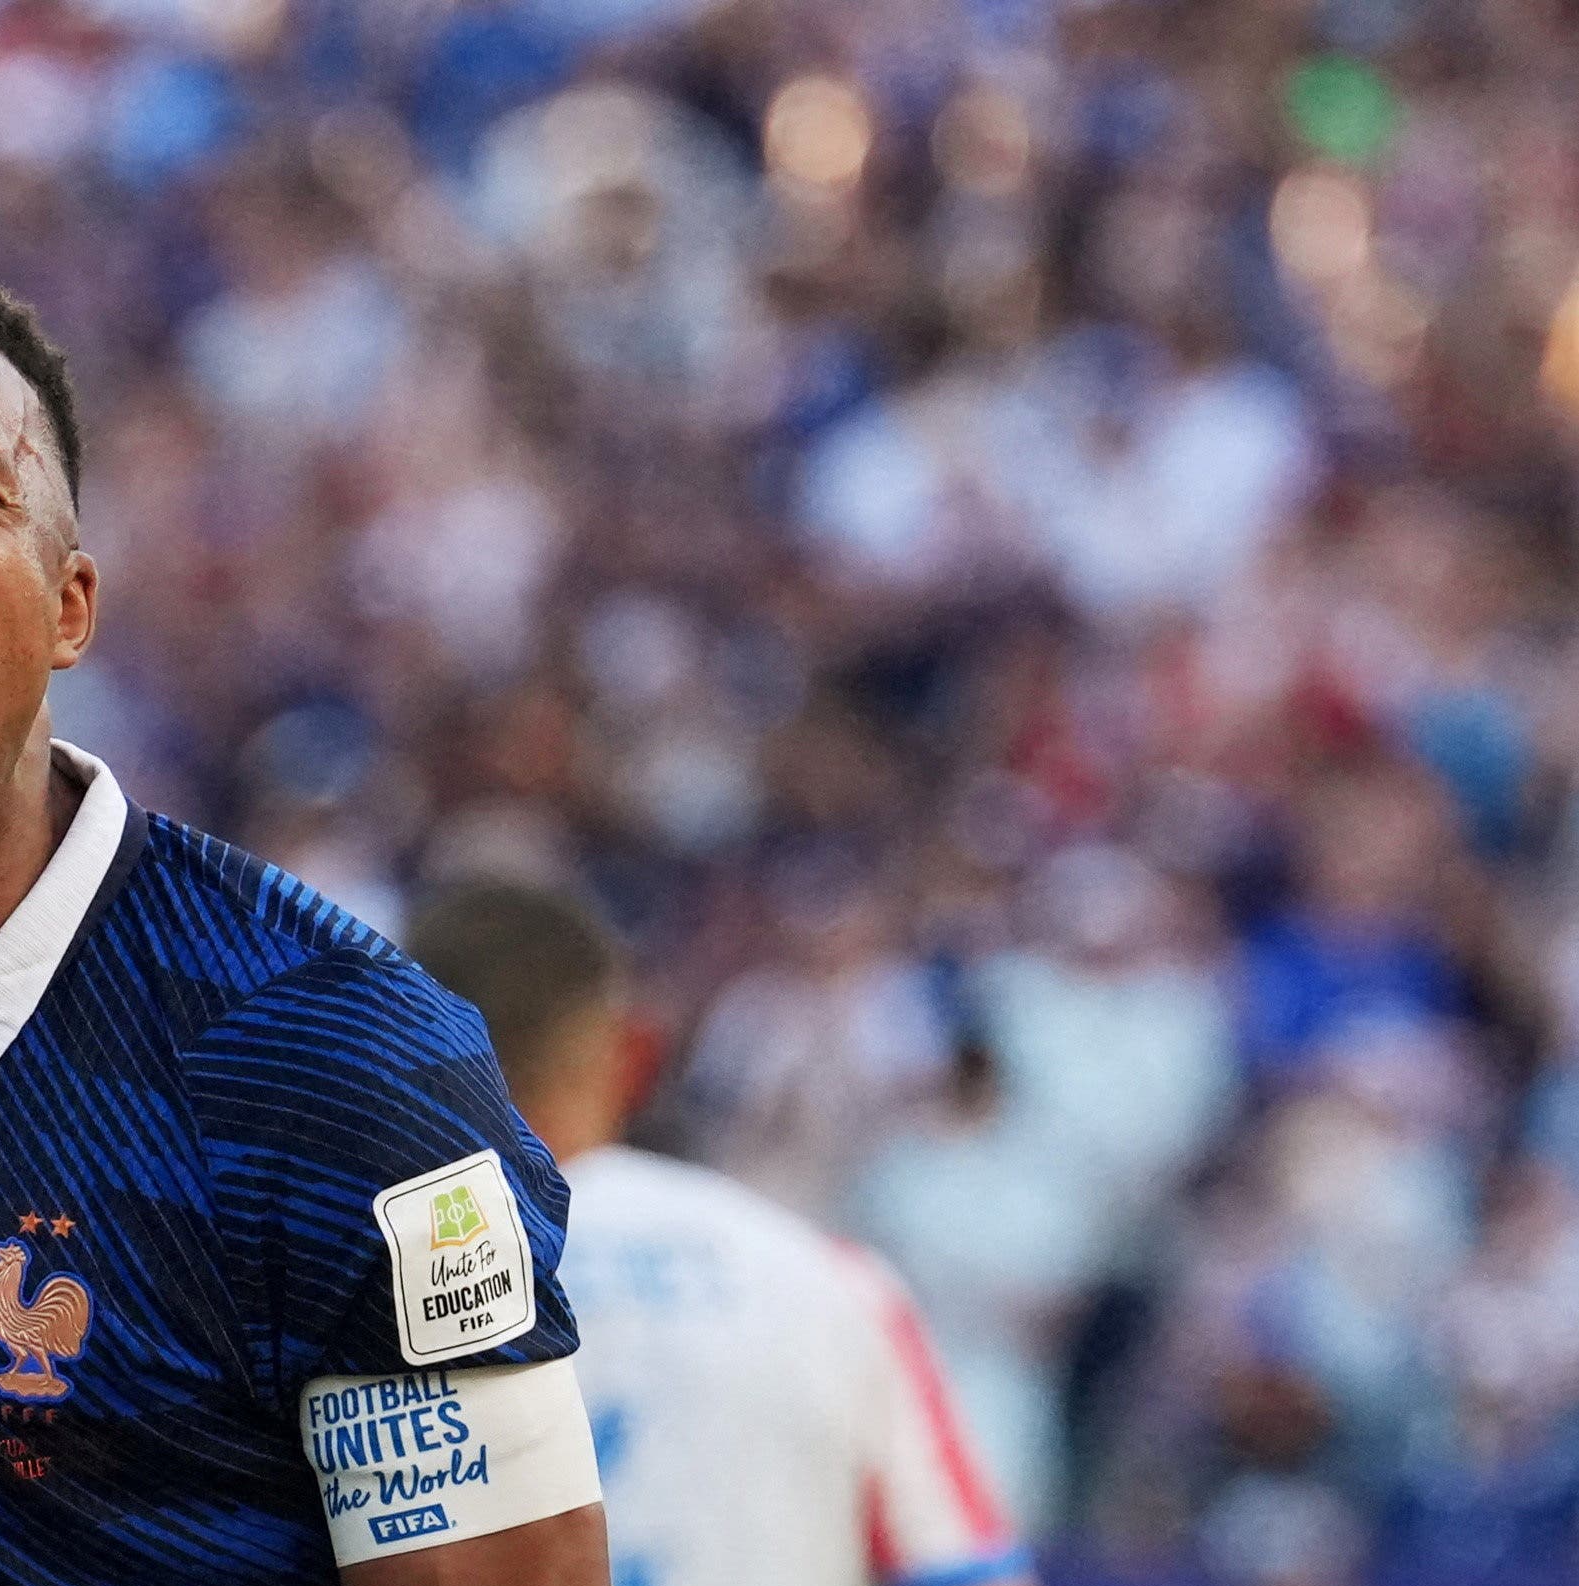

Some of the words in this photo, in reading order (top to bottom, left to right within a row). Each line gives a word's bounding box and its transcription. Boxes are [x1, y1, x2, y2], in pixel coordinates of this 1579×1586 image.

[431, 1252, 477, 1288] Unite
[475, 1239, 497, 1271] For
[422, 1268, 512, 1322] EDUCATION
[459, 1311, 494, 1333] FIFA
[308, 1369, 458, 1428] FOOTBALL
[312, 1400, 470, 1475] UNITES
[323, 1476, 371, 1519] the
[372, 1444, 489, 1506] World
[375, 1508, 442, 1539] FIFA
